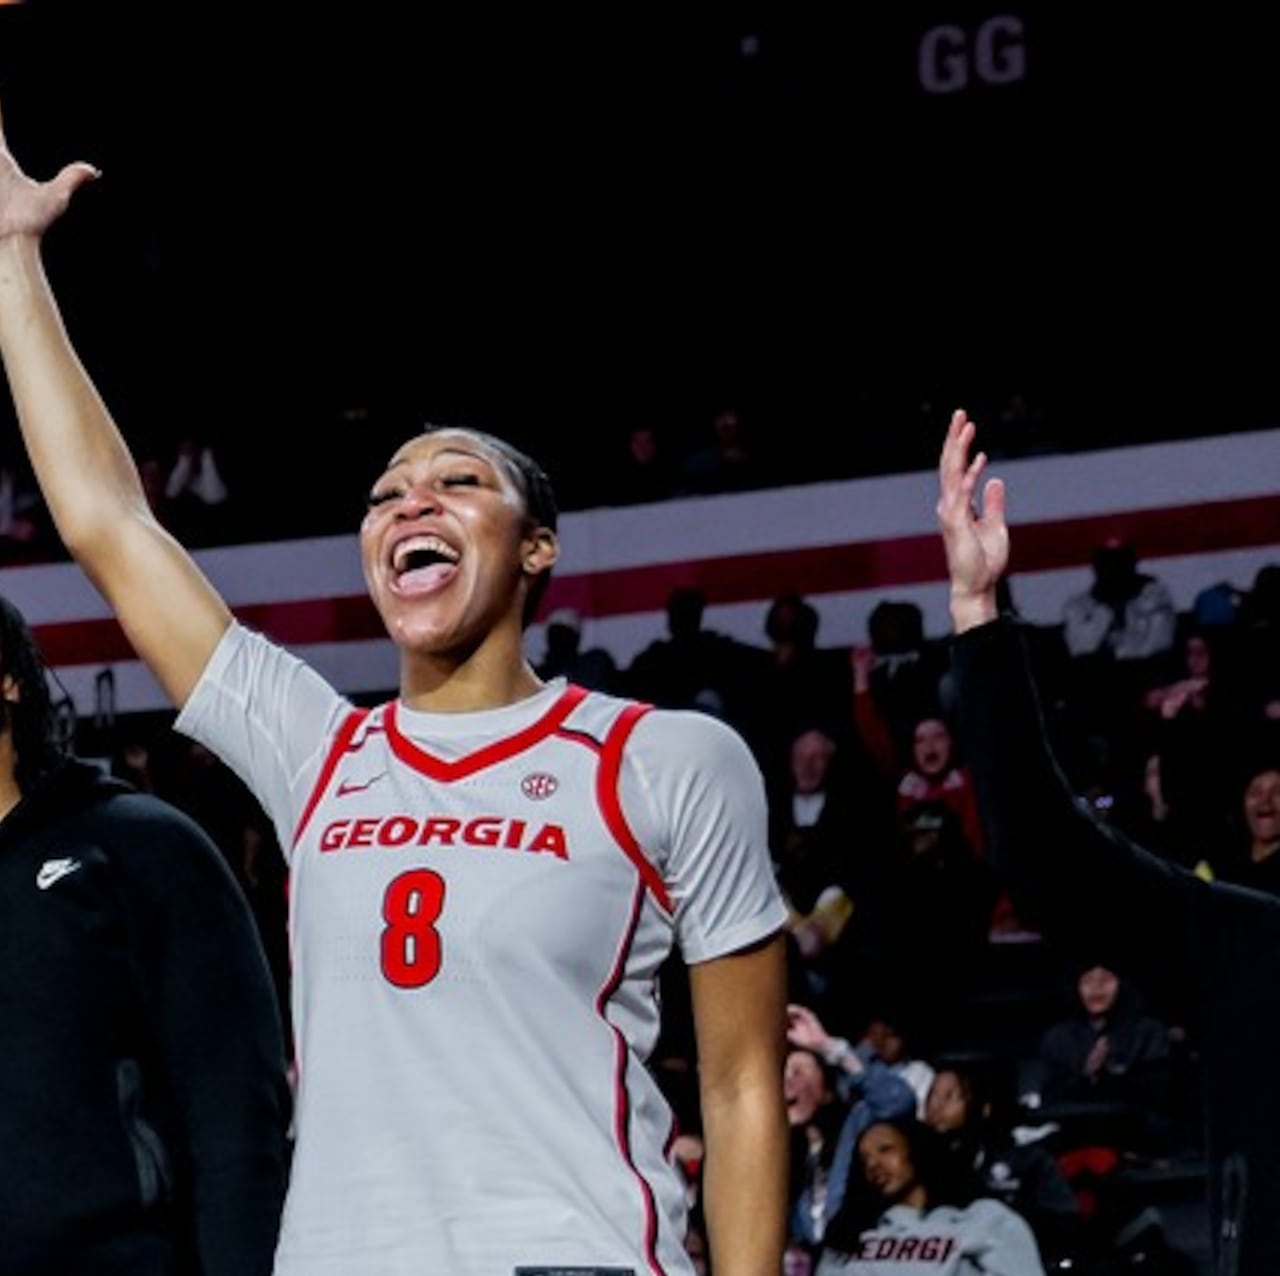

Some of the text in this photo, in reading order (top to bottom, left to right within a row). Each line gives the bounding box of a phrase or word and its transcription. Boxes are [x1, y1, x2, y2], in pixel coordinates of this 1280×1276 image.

[920, 16, 1024, 91] GG
[319, 815, 570, 862] GEORGIA
[380, 867, 446, 990] 8
[847, 1235, 955, 1265] EORGI
